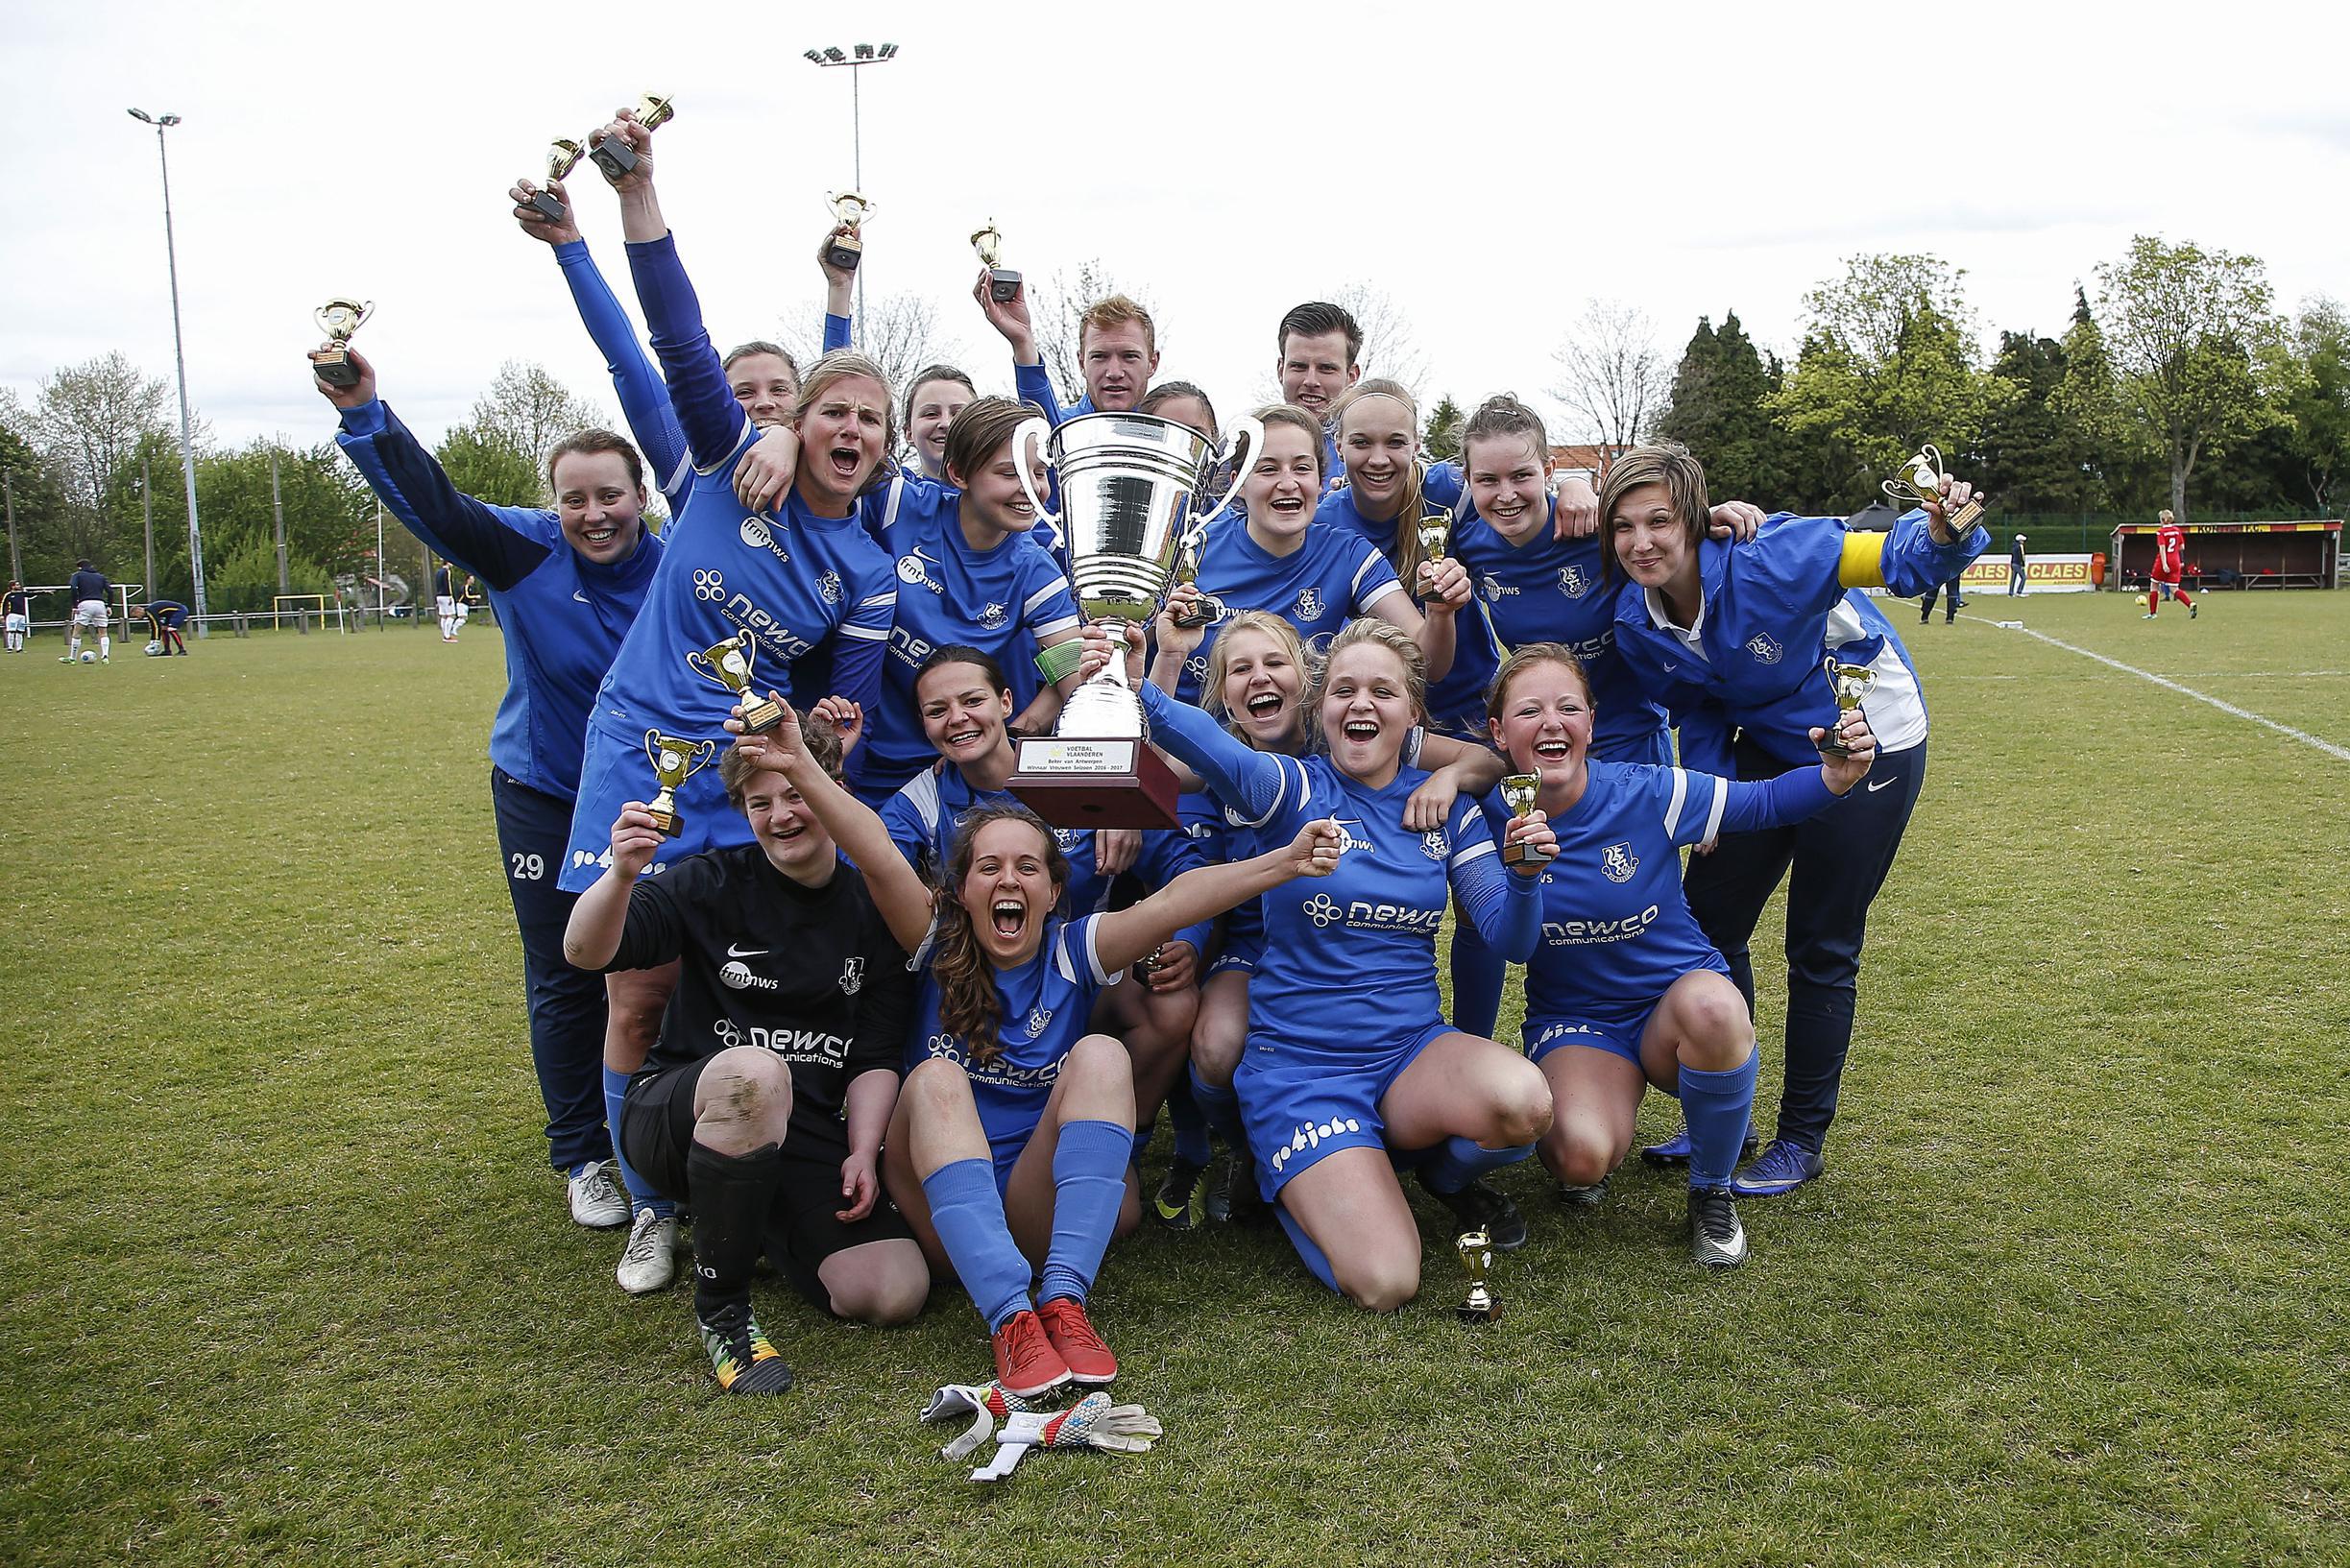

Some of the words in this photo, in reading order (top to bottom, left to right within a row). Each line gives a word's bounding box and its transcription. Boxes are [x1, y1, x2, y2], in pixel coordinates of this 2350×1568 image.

[743, 519, 789, 563] frntnws
[2168, 538, 2176, 552] 2
[900, 558, 944, 594] frntnws
[1963, 565, 2006, 578] LAES
[2029, 564, 2085, 579] CLAES
[727, 592, 815, 657] newc
[511, 852, 545, 880] 29
[1348, 901, 1443, 929] newc
[1541, 905, 1659, 937] newco
[1548, 928, 1645, 946] communications
[721, 966, 779, 990] frntnws
[779, 1051, 843, 1069] unications
[1272, 1116, 1360, 1172] go4jobs
